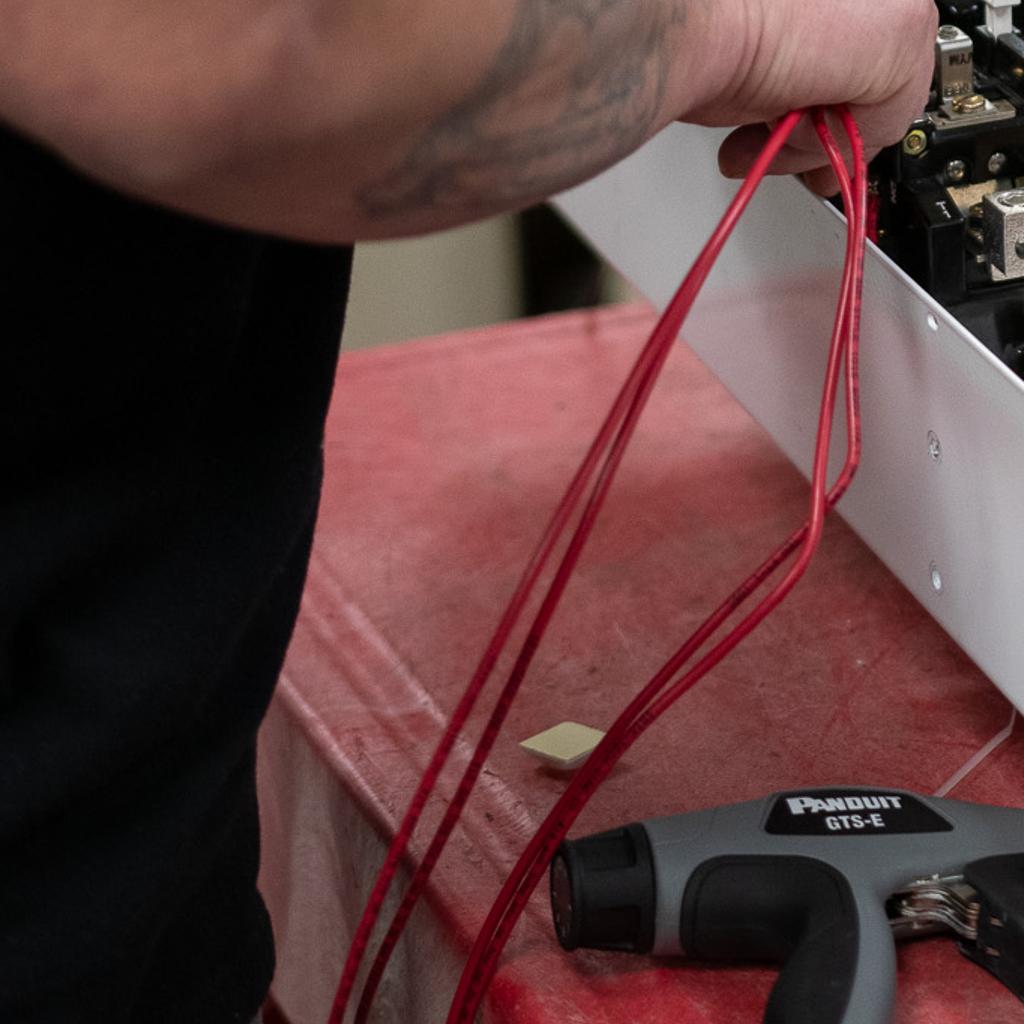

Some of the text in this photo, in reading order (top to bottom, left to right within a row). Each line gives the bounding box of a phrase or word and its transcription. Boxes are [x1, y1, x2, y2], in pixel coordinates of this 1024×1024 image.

[935, 200, 952, 218] T1
[786, 796, 903, 815] PANDUIT
[825, 814, 886, 830] GTS-E
